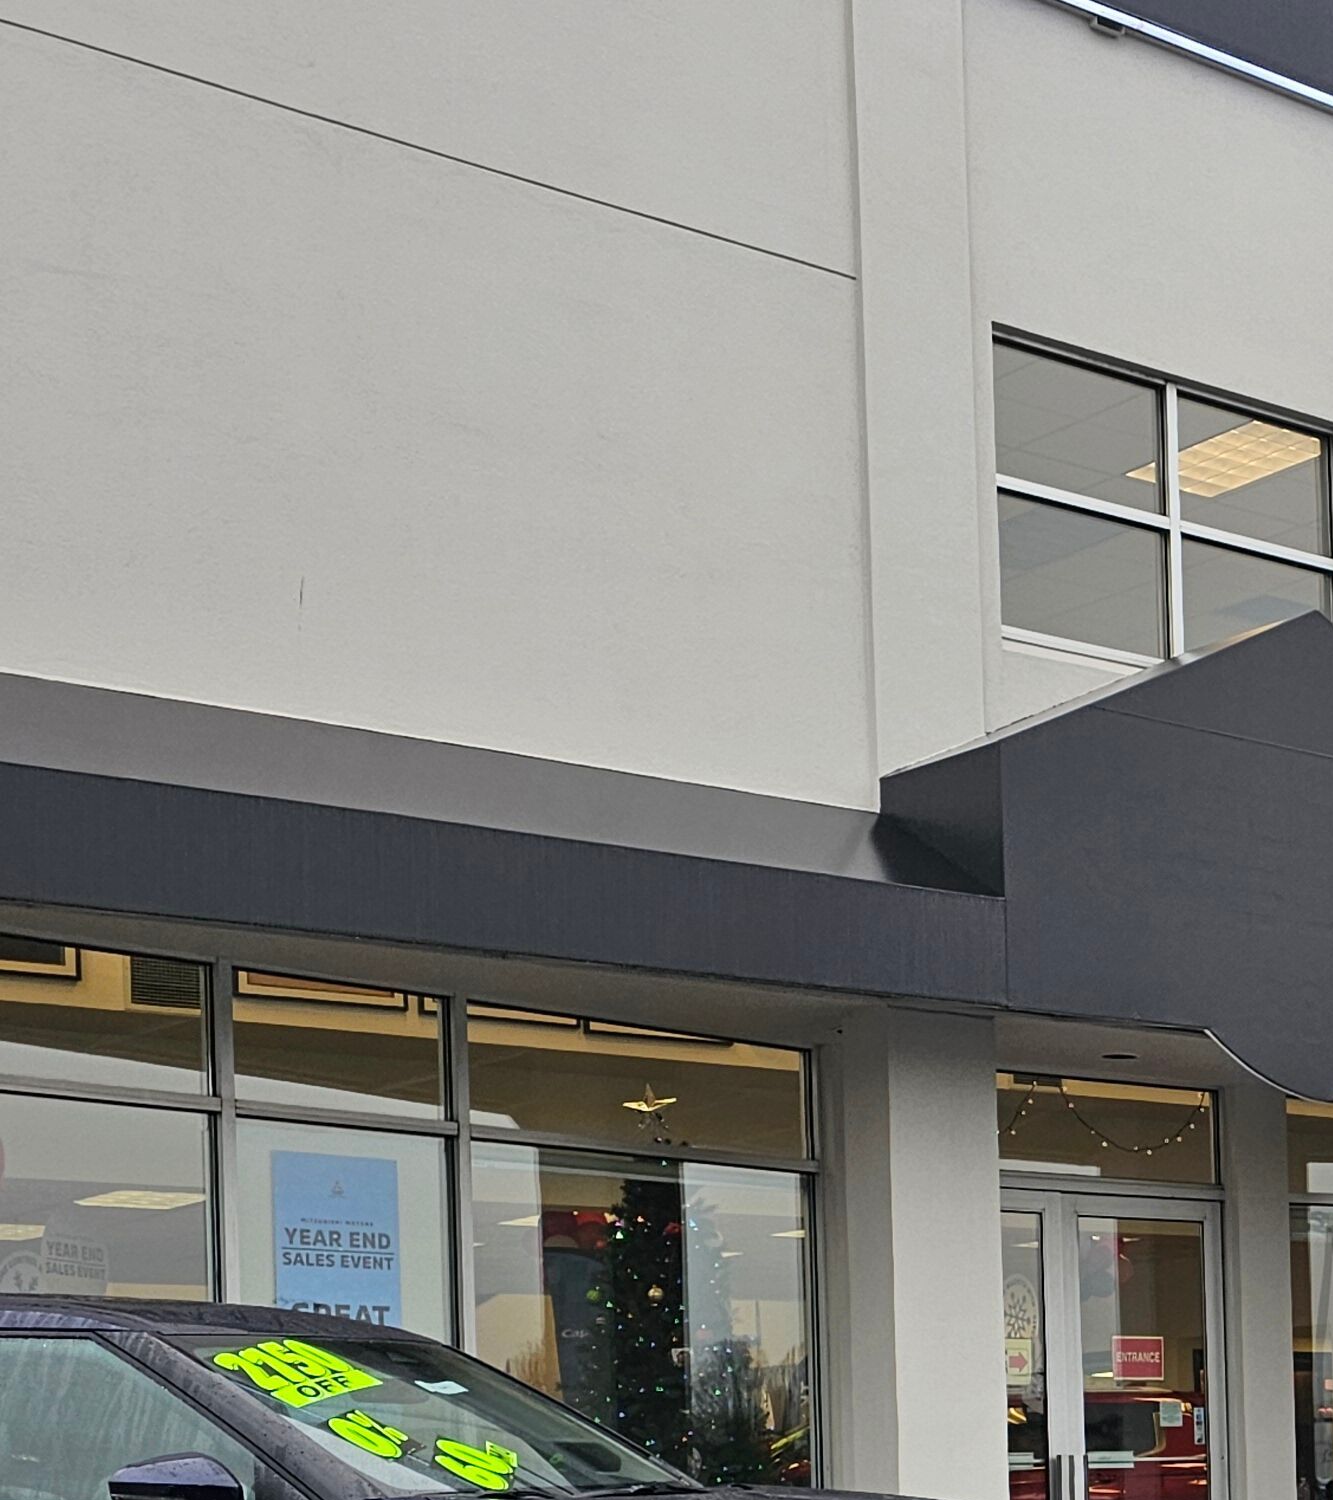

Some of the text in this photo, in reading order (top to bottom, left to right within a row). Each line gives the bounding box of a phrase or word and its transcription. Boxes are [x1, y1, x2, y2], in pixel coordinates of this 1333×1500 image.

[284, 1228, 391, 1250] YEAR END
[46, 1240, 104, 1263] YEAR END
[283, 1252, 394, 1271] SALES EVENT
[46, 1262, 76, 1278] SALES
[78, 1265, 105, 1281] EVENT
[1116, 1351, 1161, 1364] ENTRANCE
[297, 1375, 352, 1398] OFF
[328, 1409, 409, 1458] 0%
[434, 1439, 514, 1490] 60
